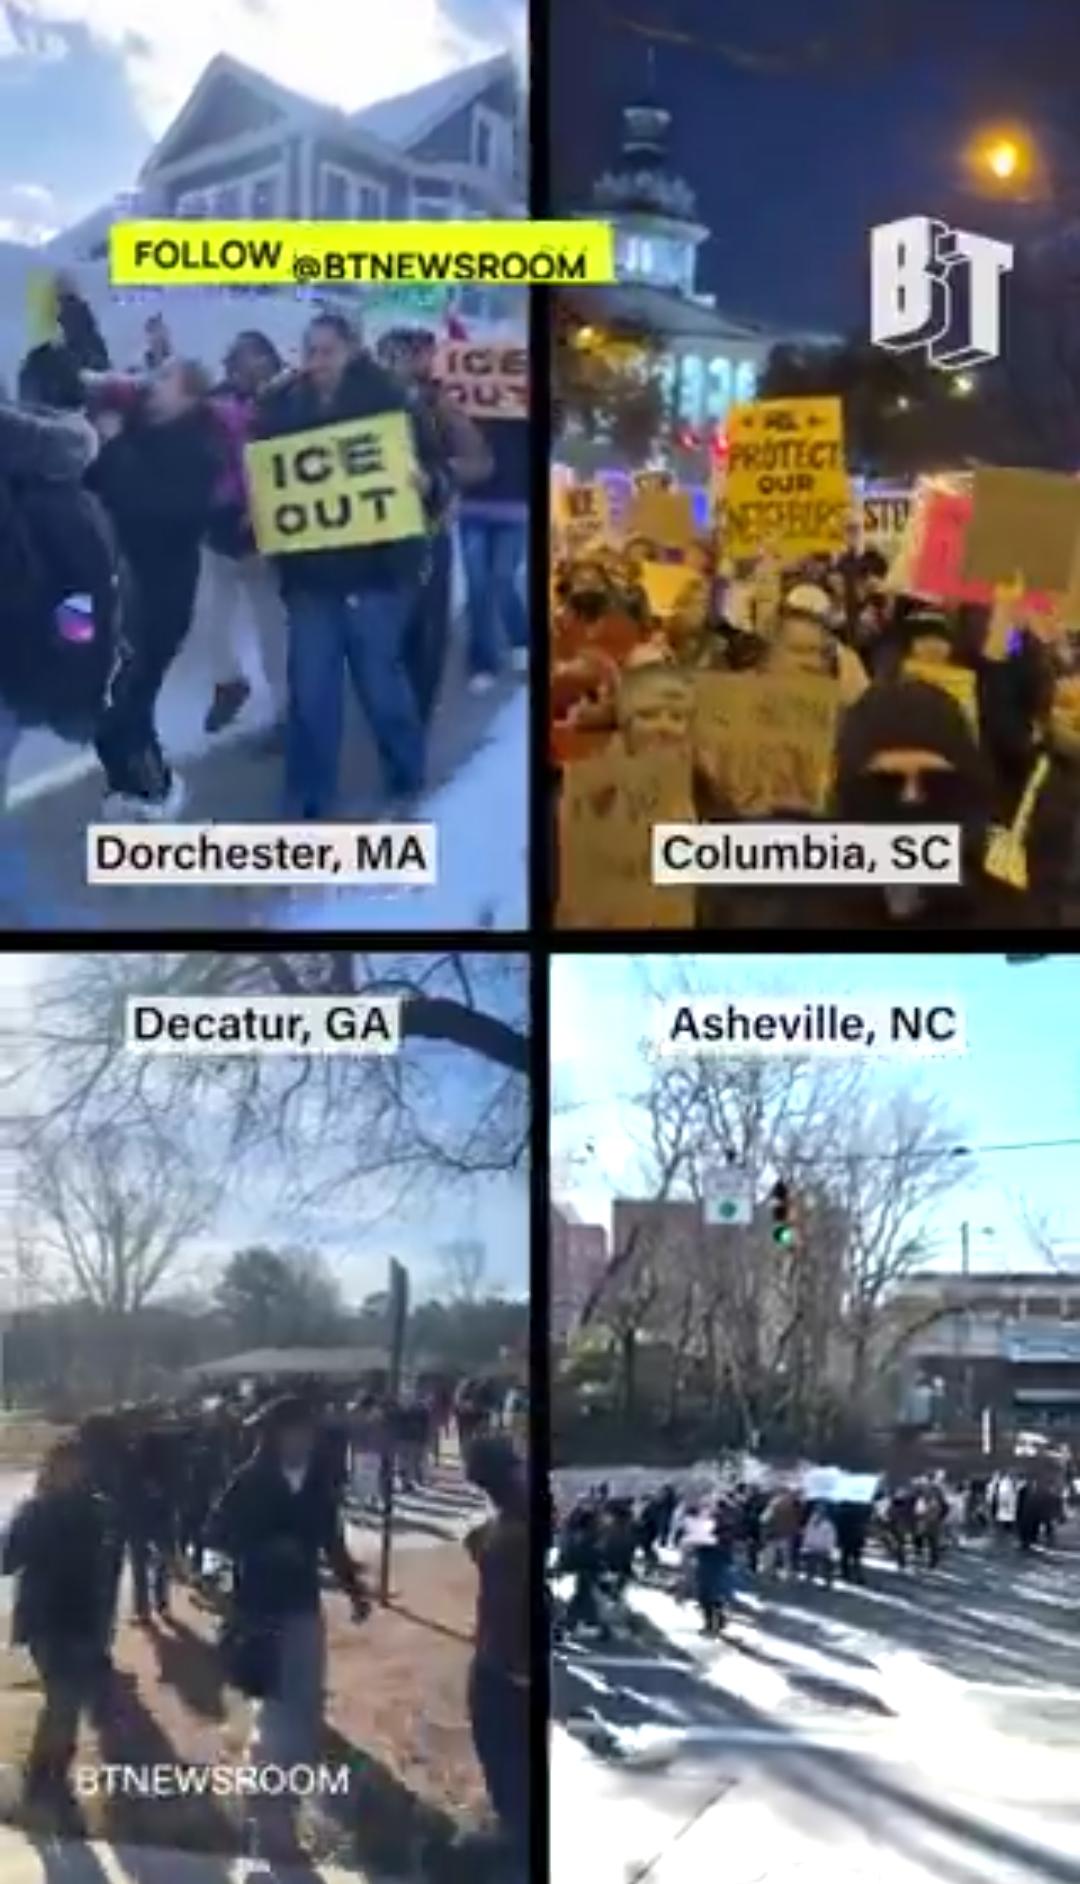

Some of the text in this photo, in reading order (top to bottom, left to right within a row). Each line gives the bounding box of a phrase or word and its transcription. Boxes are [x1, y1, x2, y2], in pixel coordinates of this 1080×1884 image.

[447, 350, 530, 375] ICE
[272, 434, 385, 489] ICE
[729, 438, 839, 472] PROTECT
[757, 474, 815, 494] OUR
[274, 489, 397, 535] OUT
